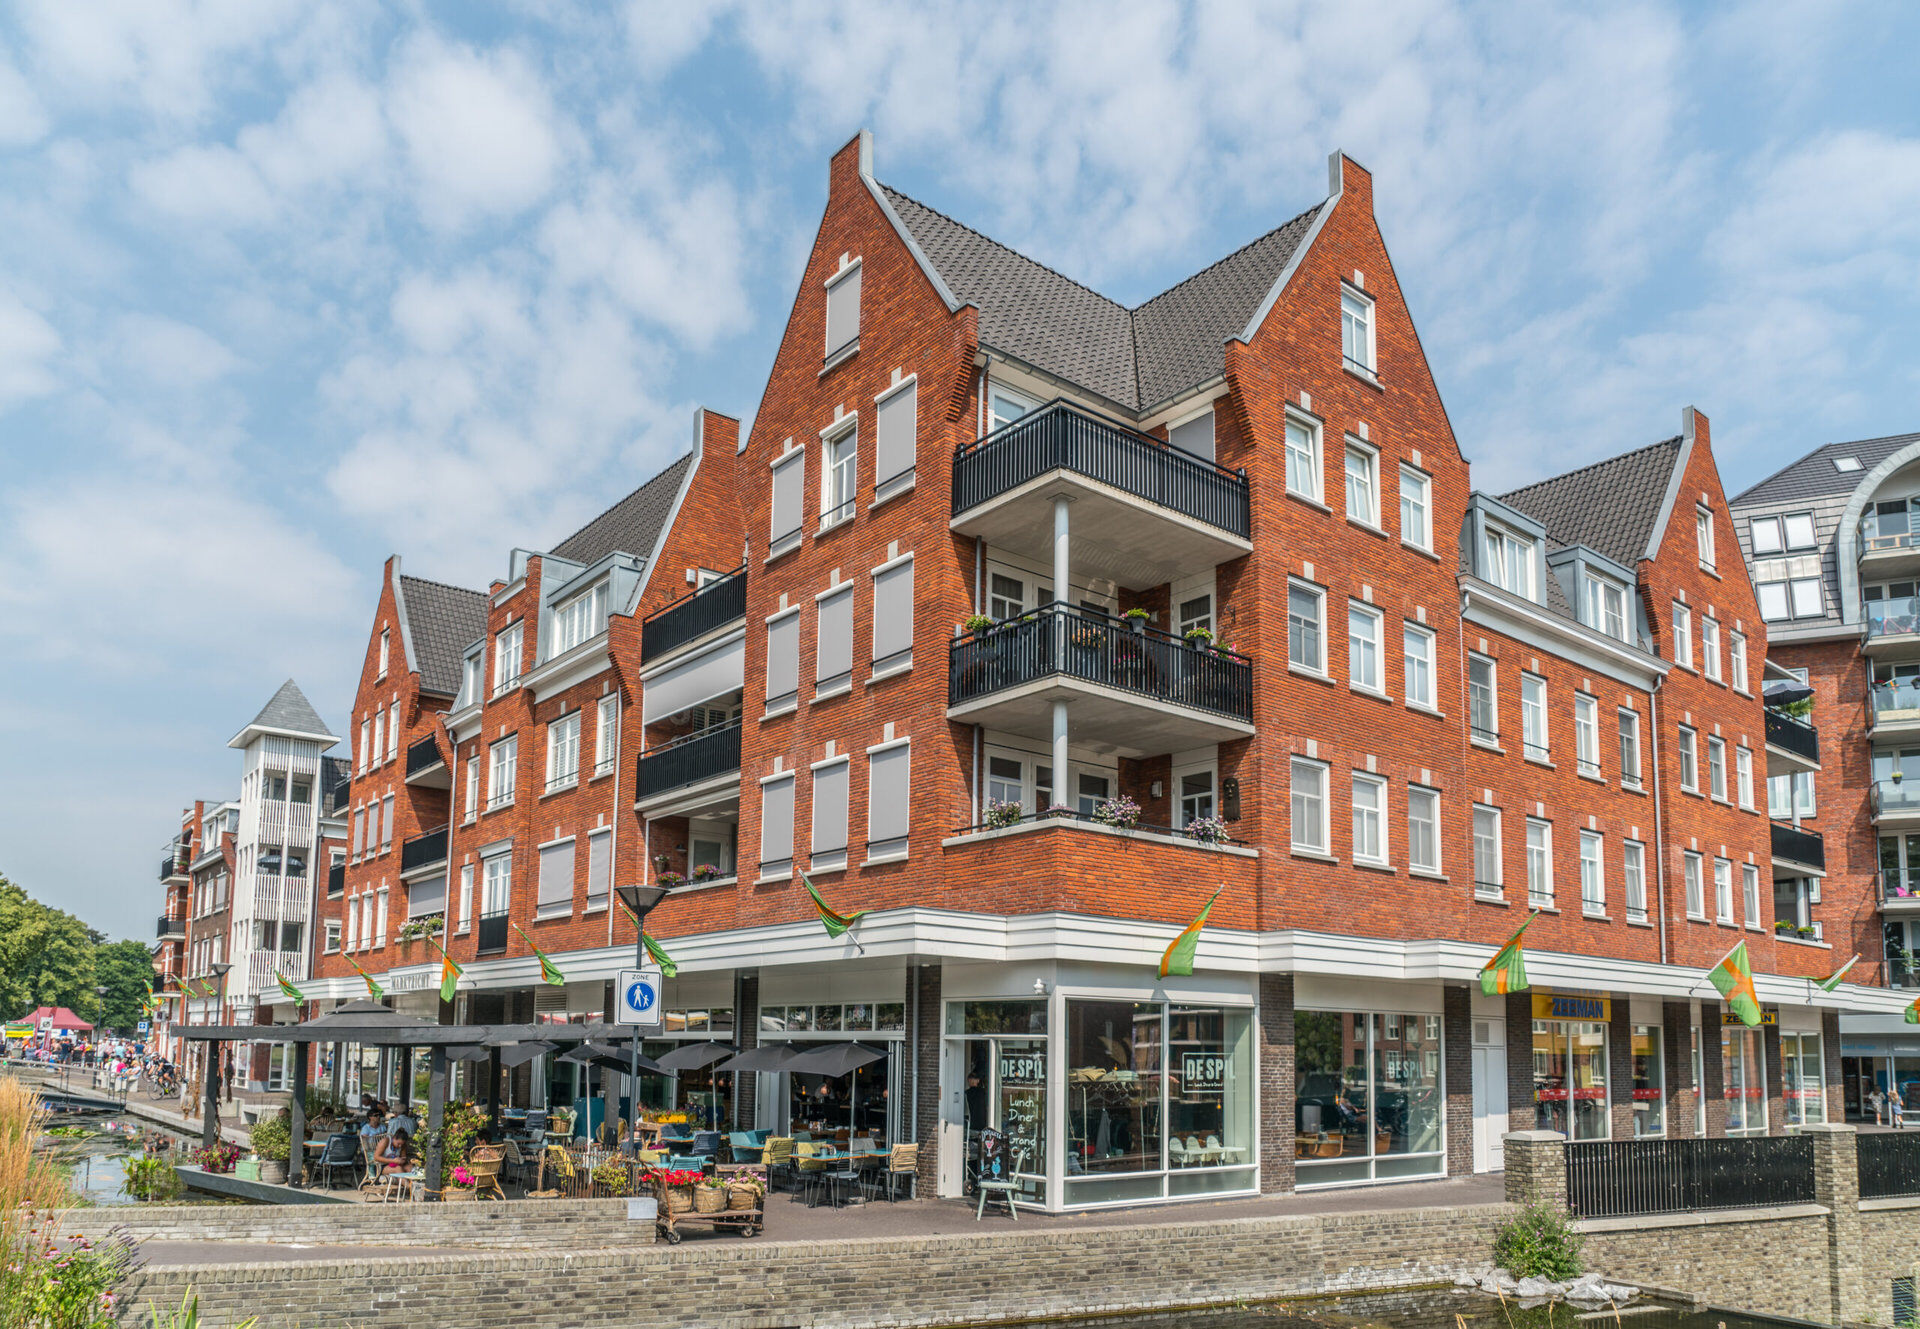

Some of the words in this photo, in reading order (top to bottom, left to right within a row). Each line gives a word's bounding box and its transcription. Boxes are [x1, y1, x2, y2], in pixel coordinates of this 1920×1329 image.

[1552, 998, 1604, 1019] ZEEMAN
[1726, 1015, 1772, 1023] ZEN
[1001, 1059, 1016, 1078] DE
[1017, 1059, 1045, 1079] SPIL
[1186, 1059, 1204, 1081] DE
[1206, 1058, 1236, 1080] SPIL
[1388, 1061, 1402, 1079] DE
[1402, 1060, 1425, 1080] SPIL
[1009, 1094, 1035, 1107] Lunch
[1008, 1109, 1034, 1122] Diner
[1008, 1132, 1037, 1146] Grand
[1010, 1146, 1031, 1160] Cfé
